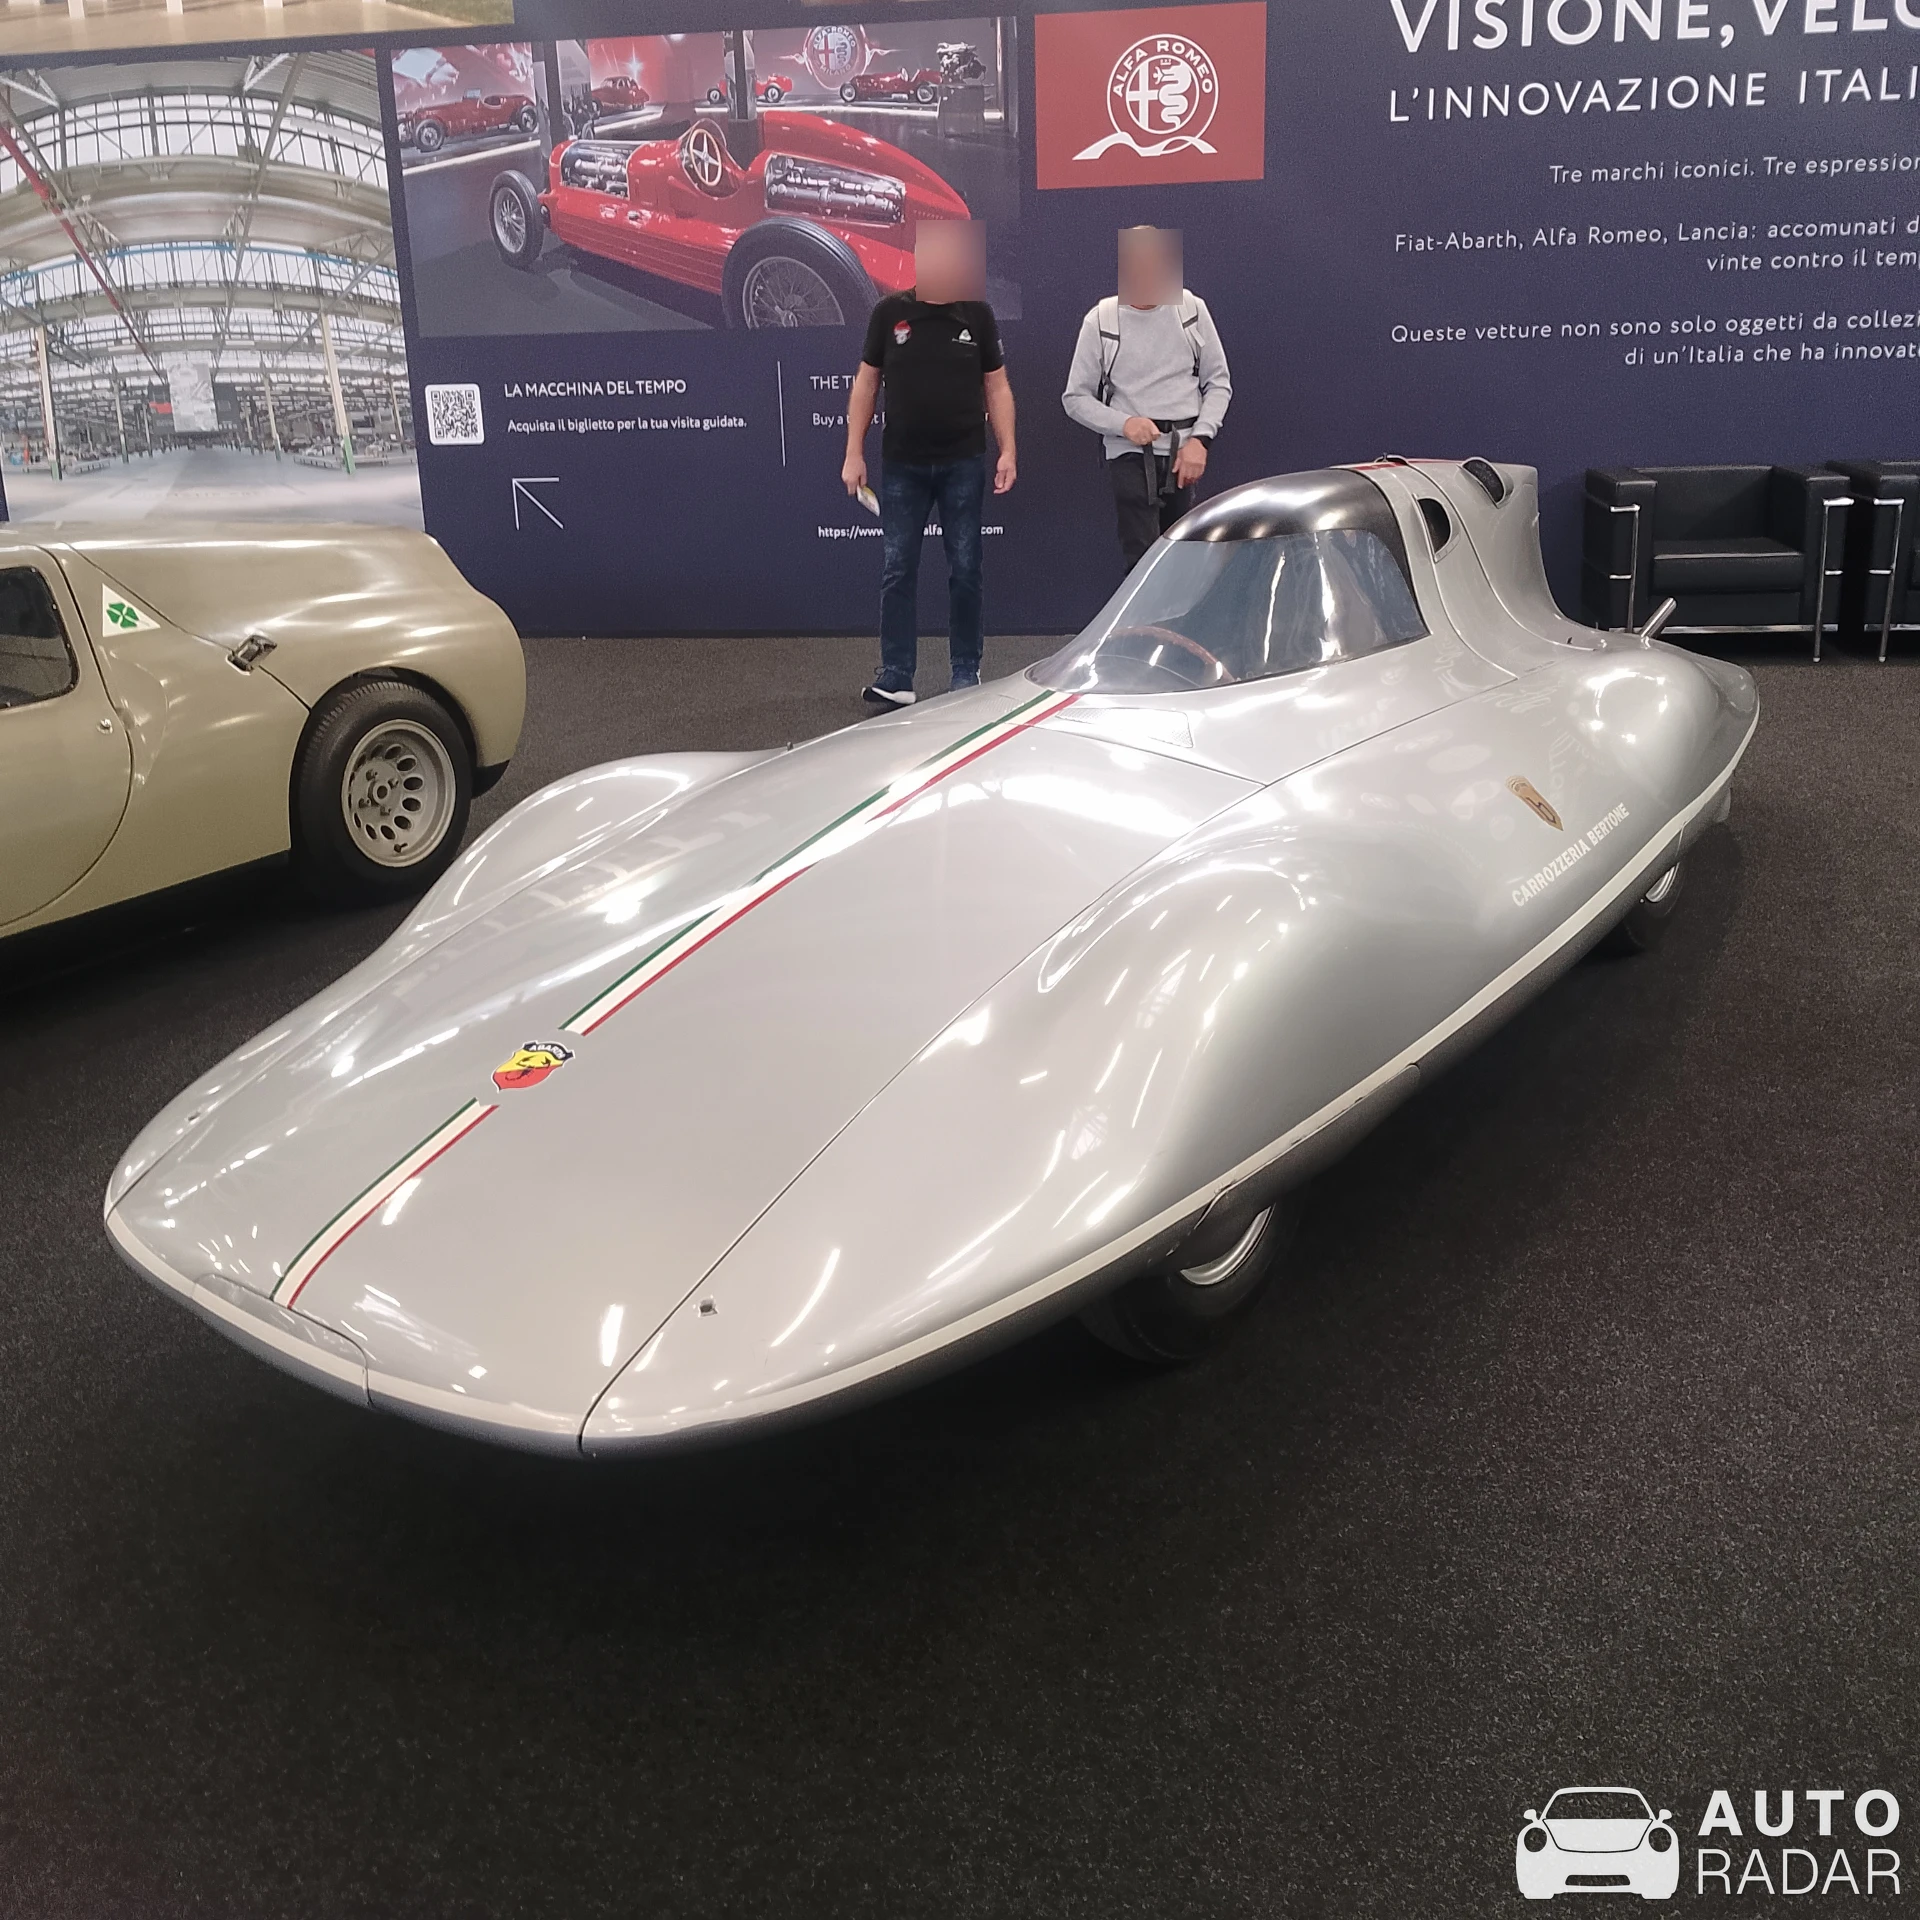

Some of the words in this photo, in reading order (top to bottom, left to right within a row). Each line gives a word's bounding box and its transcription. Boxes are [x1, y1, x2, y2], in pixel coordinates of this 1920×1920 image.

[1390, 0, 1735, 53] VISIONE,
[1113, 48, 1148, 97] ALFA
[1157, 40, 1213, 94] ROMEO
[1390, 72, 1767, 122] L'INNOVAZIONE
[1799, 65, 1918, 104] ITALI
[1549, 165, 1583, 184] Tre
[1591, 161, 1664, 182] marchi
[1674, 158, 1755, 179] iconici.
[1763, 156, 1797, 176] Tre
[1395, 230, 1524, 252] Fiat-Abarth,
[1532, 228, 1577, 247] Alfa
[1588, 226, 1668, 246] Romeo,
[1678, 221, 1756, 241] Lancia:
[1767, 216, 1896, 239] accomunati
[1706, 253, 1762, 272] vinte
[1770, 252, 1844, 270] contro
[1853, 247, 1867, 267] il
[1876, 250, 1920, 270] tem
[1391, 324, 1467, 343] Queste
[1475, 323, 1552, 340] vetture
[1561, 323, 1600, 337] non
[1609, 321, 1661, 336] sono
[1670, 314, 1717, 334] solo
[1725, 312, 1804, 336] oggetti
[1813, 311, 1838, 330] da
[1625, 347, 1644, 365] di
[1653, 345, 1744, 365] un'Italia
[1753, 343, 1792, 362] che
[1801, 342, 1826, 360] ha
[1834, 341, 1920, 360] innovat
[504, 383, 523, 398] LA
[525, 381, 604, 397] MACCHINA
[606, 380, 635, 396] DEL
[635, 379, 687, 395] TEMPO
[809, 375, 840, 390] THE
[507, 419, 556, 435] Acquista
[557, 418, 566, 432] il
[567, 417, 615, 434] biglietto
[617, 420, 636, 433] per
[637, 417, 648, 430] la
[650, 418, 669, 430] tua
[670, 416, 701, 430] visita
[702, 414, 748, 431] guidata.
[812, 412, 835, 428] Buy
[836, 415, 844, 425] a
[1511, 838, 1591, 907] CARROZZERIA
[1586, 802, 1630, 847] BERTONE
